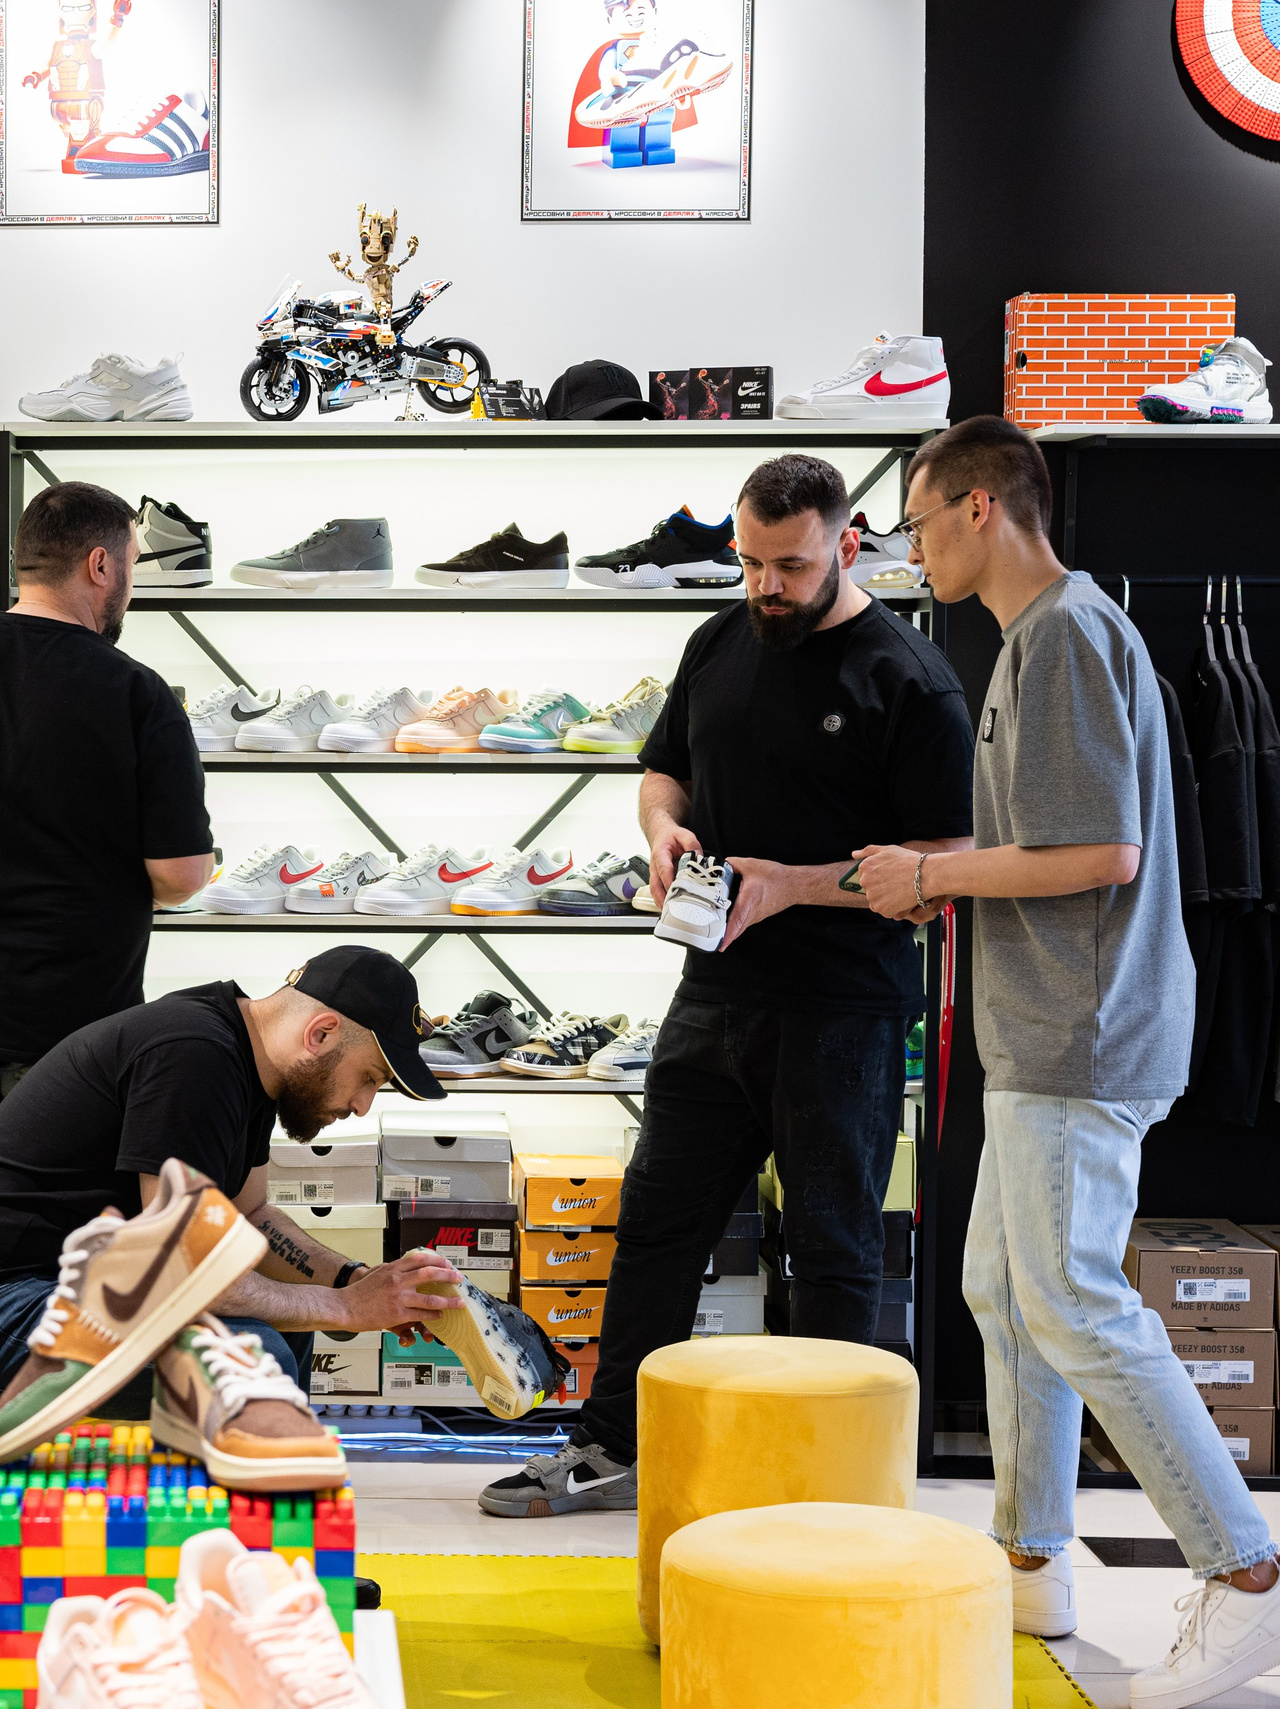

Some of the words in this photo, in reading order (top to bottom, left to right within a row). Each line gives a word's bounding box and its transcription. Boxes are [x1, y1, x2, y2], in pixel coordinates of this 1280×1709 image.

[618, 564, 630, 573] 23
[560, 1192, 597, 1209] union
[434, 1227, 476, 1245] NIKE
[269, 1228, 283, 1240] vis
[280, 1237, 309, 1262] pacem
[554, 1246, 591, 1262] union
[1170, 1266, 1197, 1274] YEEZY
[1199, 1266, 1226, 1275] BOOST
[1228, 1267, 1244, 1275] 350
[556, 1303, 592, 1320] union
[1171, 1302, 1194, 1310] MADE
[1197, 1303, 1208, 1311] BY
[1210, 1303, 1241, 1311] ADIDAS
[1172, 1345, 1198, 1353] YEEZY
[1201, 1345, 1227, 1353] BOOST
[1223, 1425, 1238, 1433] 350
